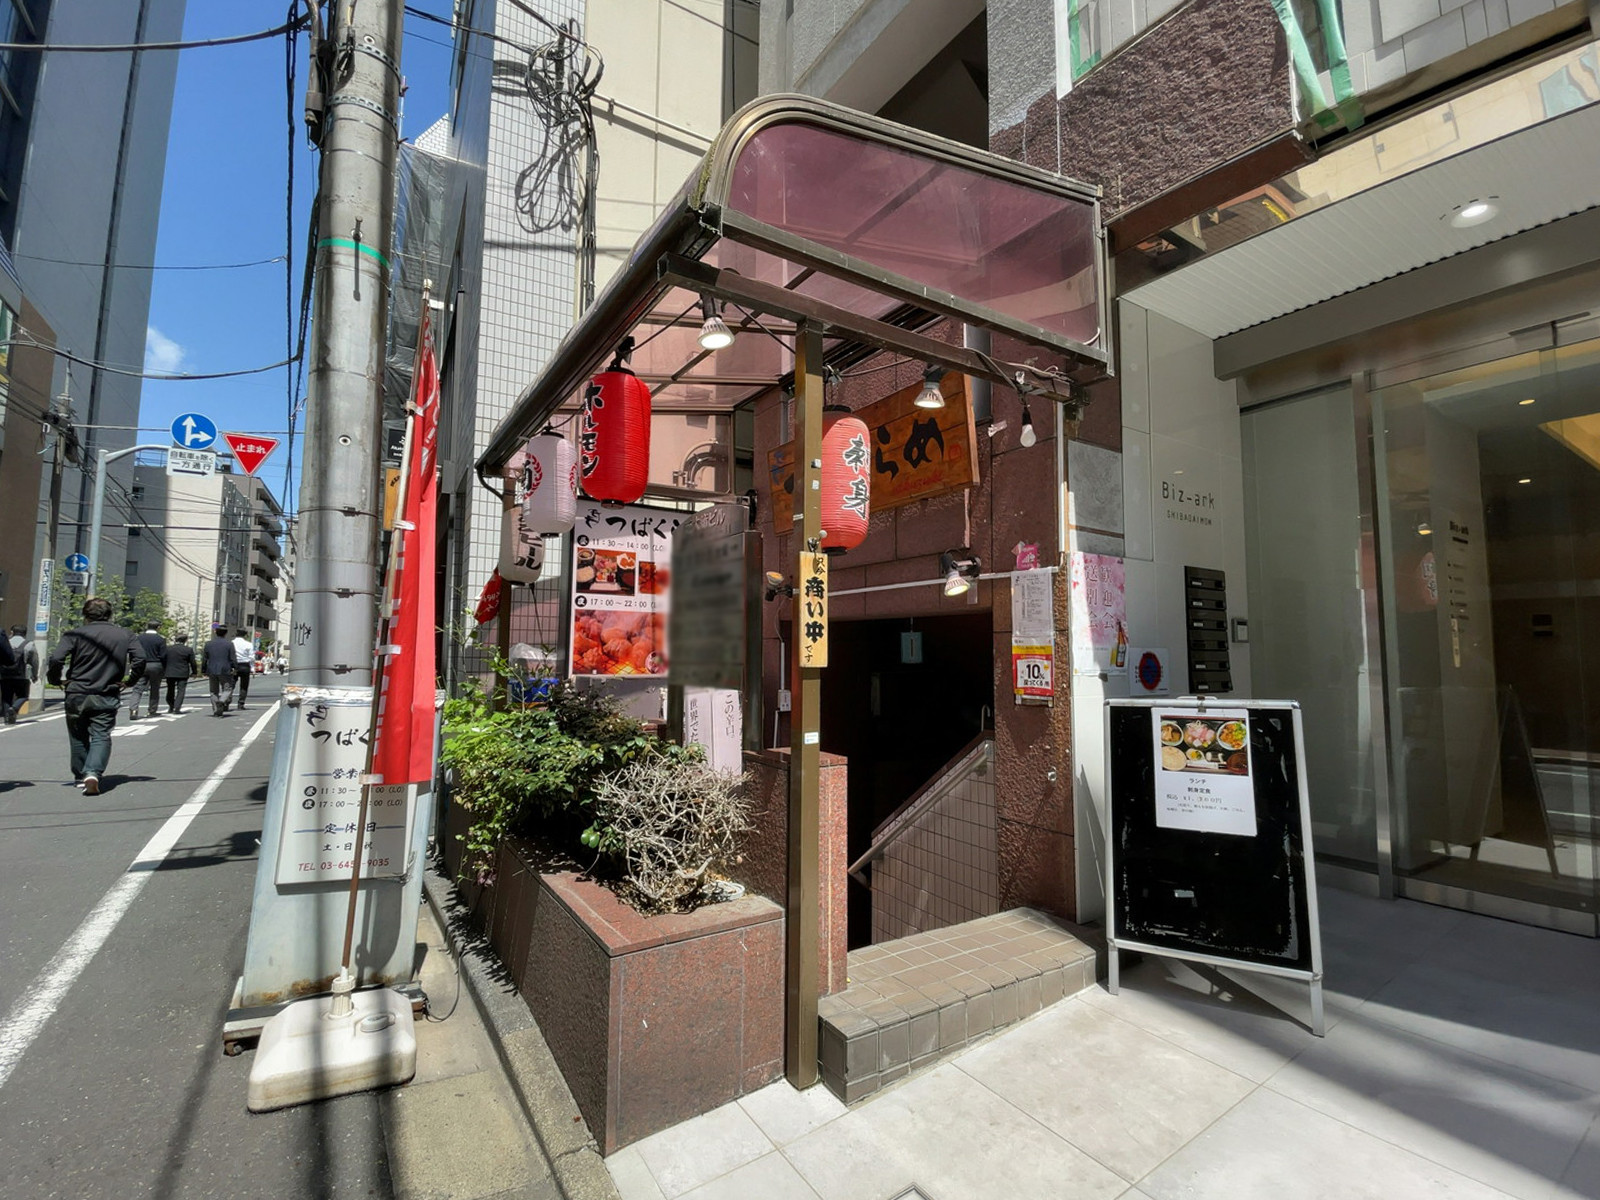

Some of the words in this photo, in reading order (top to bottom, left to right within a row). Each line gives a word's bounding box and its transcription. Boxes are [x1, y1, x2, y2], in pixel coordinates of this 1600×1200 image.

[235, 442, 267, 454] 止まれ
[170, 450, 214, 462] 自転車を除く
[171, 460, 212, 471] 一方通行
[1162, 481, 1215, 509] Biz-ark
[1167, 509, 1212, 526] SHIBADAIMON
[805, 576, 825, 643] 商い中
[298, 863, 316, 872] TEL
[320, 858, 390, 870] 03-645-9035
